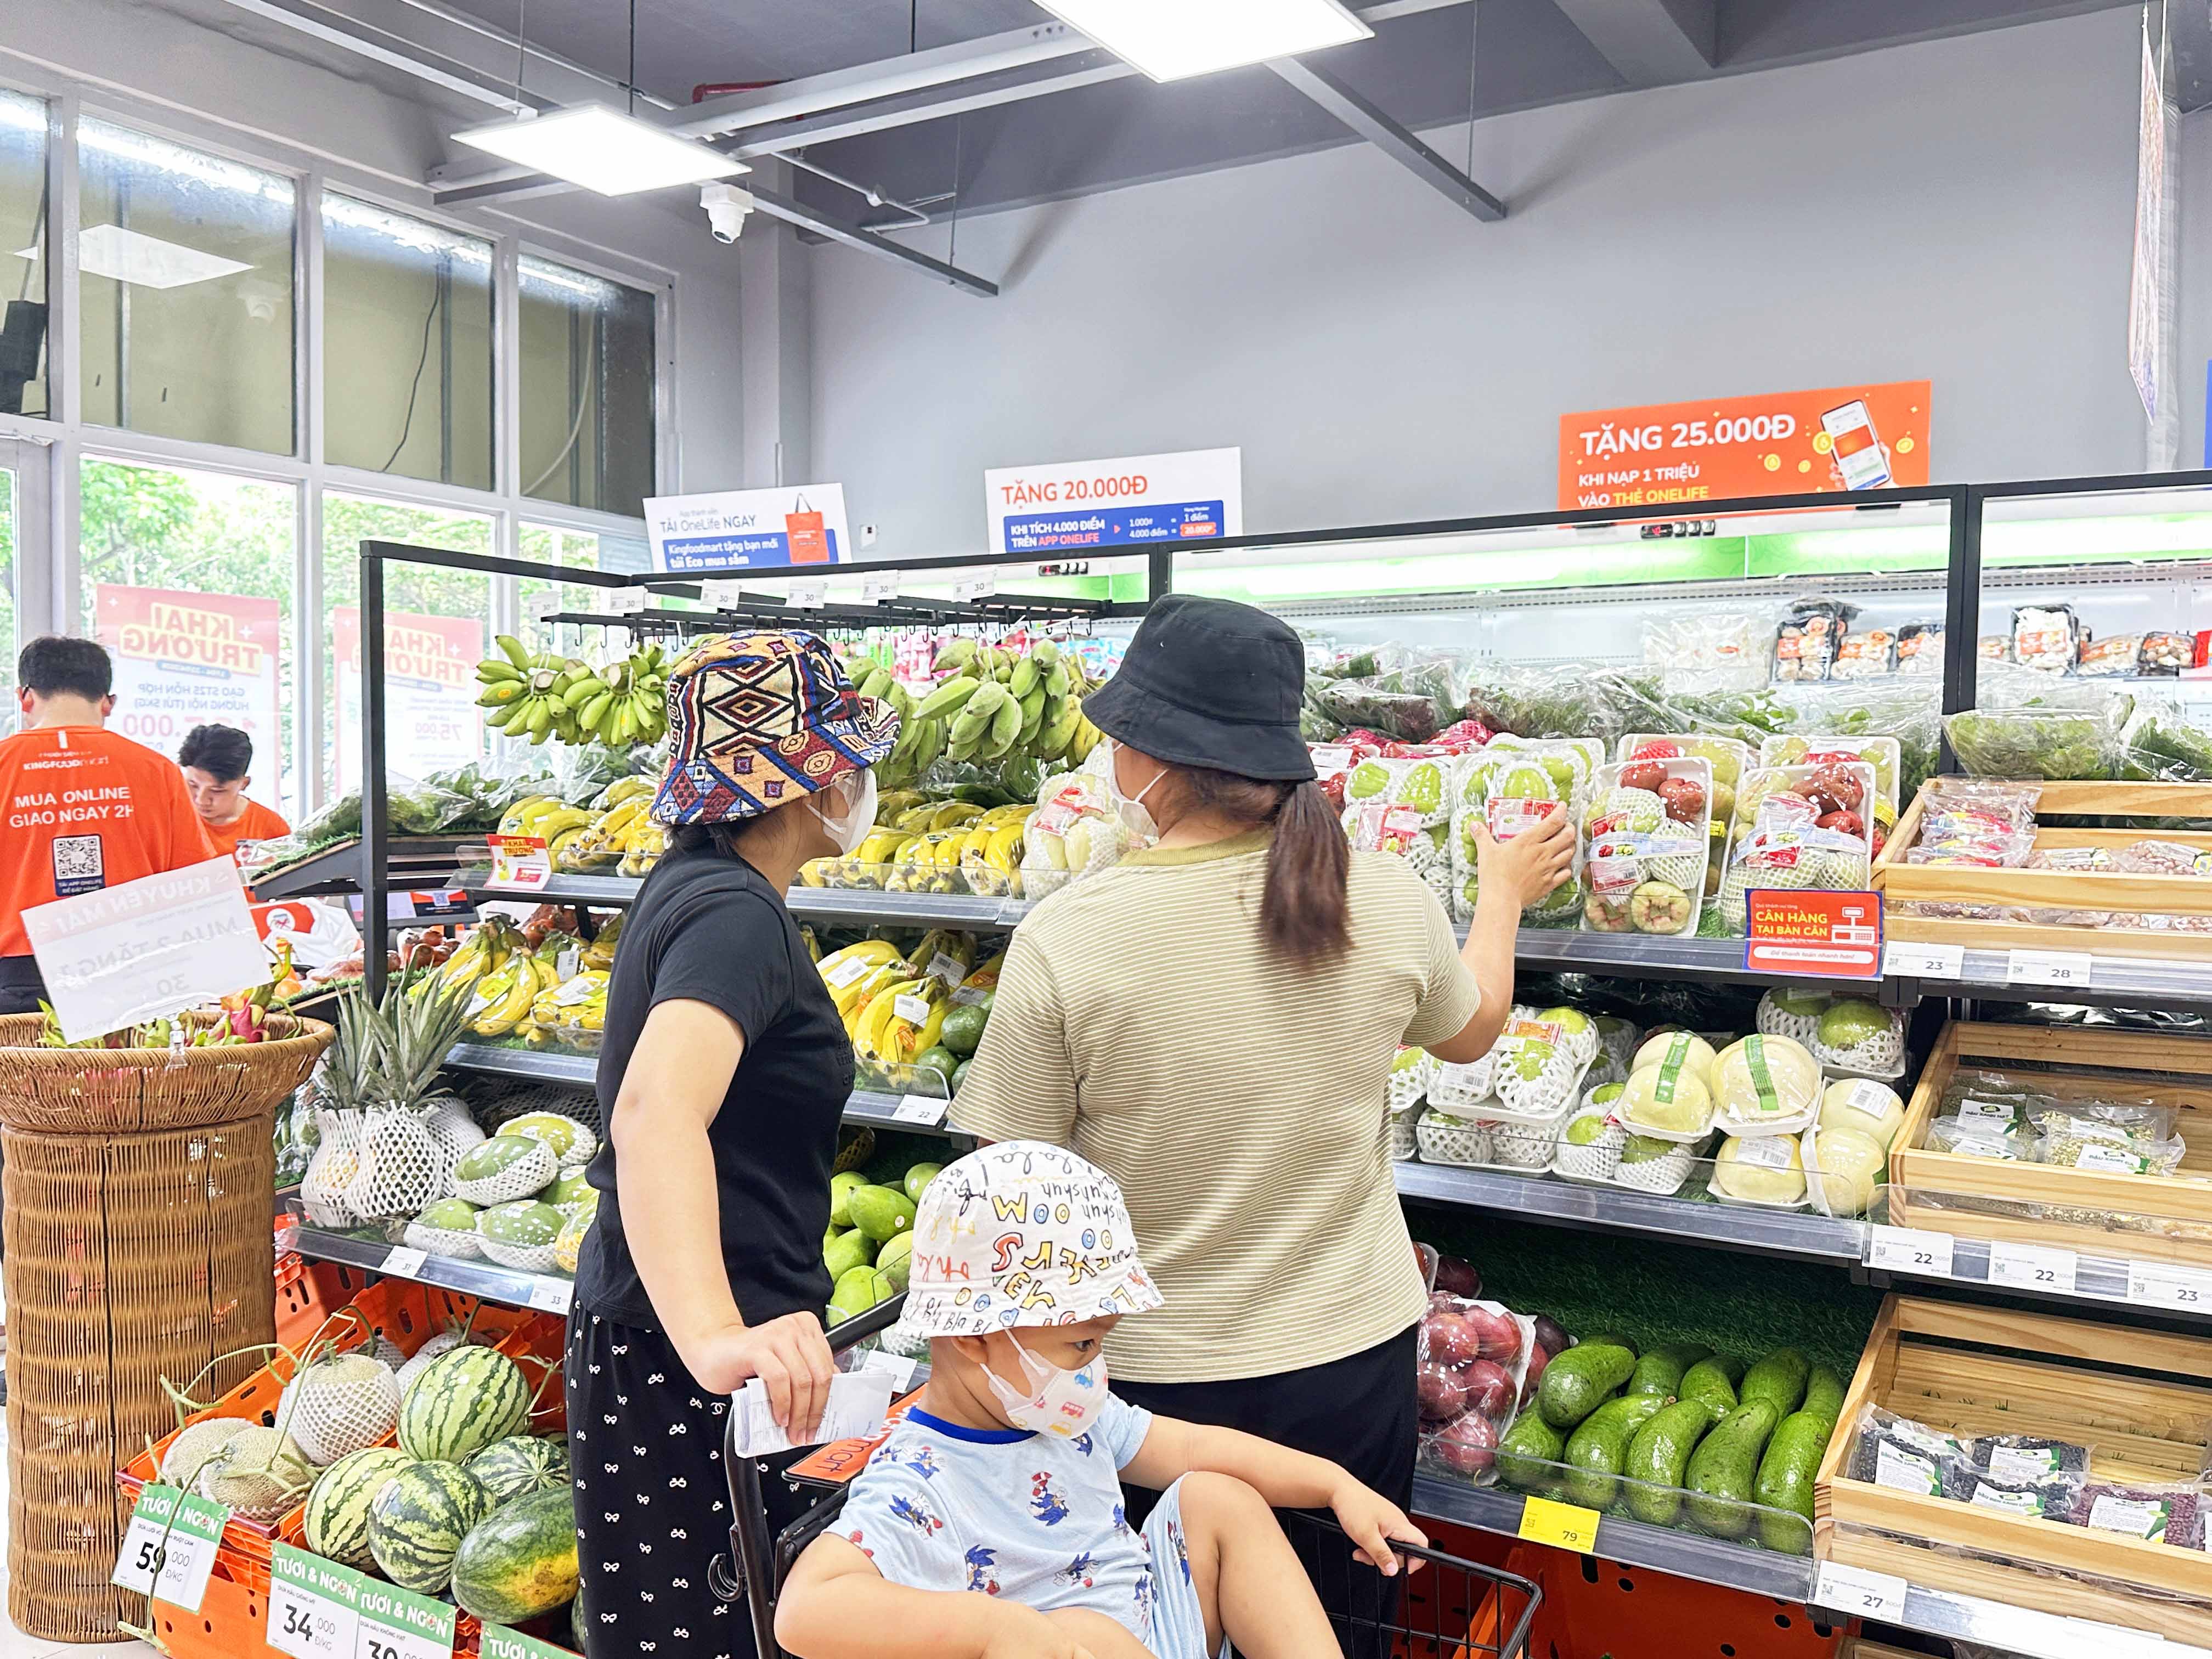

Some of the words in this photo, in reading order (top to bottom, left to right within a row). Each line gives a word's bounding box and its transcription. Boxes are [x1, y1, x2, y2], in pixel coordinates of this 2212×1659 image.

[1579, 422, 1663, 460] TẶNG
[1671, 415, 1796, 449] 25.000Đ
[1578, 471, 1604, 487] KHI
[1607, 469, 1640, 488] NẠP
[1643, 467, 1652, 482] 1
[1001, 479, 1058, 509] TẶNG
[1063, 475, 1148, 500] 20.000Đ
[1578, 490, 1610, 507] VÀO
[1613, 487, 1642, 504] THẺ
[1646, 486, 1709, 502] ONELIFE
[680, 517, 720, 532] OneLife
[723, 514, 757, 528] NGAY
[1011, 524, 1028, 535] KHI
[1029, 521, 1052, 534] TÍCH
[1011, 534, 1037, 548] TRÊN
[1038, 535, 1058, 546] APP
[1059, 533, 1100, 545] ONELIFE
[668, 542, 723, 556] Kingfoodmart
[685, 556, 704, 568] Eco
[704, 557, 727, 567] mua
[879, 585, 888, 593] 30
[975, 583, 985, 592] 30
[15, 792, 57, 808] MUA
[63, 786, 131, 804] ONLINE
[9, 810, 55, 828] GIAO
[59, 805, 110, 823] NGAY
[1756, 909, 1784, 922] CÂN
[1787, 910, 1828, 924] HÀNG
[1756, 924, 1774, 936] TẠI
[1776, 923, 1801, 935] BÀN
[1803, 924, 1828, 937] CÂN
[1925, 961, 1943, 970] 23
[2051, 969, 2070, 978] 28
[918, 1110, 931, 1119] 22
[1914, 1252, 1933, 1264] 22
[2035, 1269, 2055, 1282] 22
[551, 1295, 561, 1305] 33
[2177, 1289, 2198, 1302] 23
[141, 1496, 172, 1516] TƯƠI
[1562, 1530, 1578, 1542] 79
[136, 1541, 166, 1573] 59
[276, 1557, 306, 1580] TƯƠI
[308, 1567, 317, 1584] &
[360, 1591, 391, 1616] TƯƠI
[393, 1601, 404, 1618] &
[1863, 1595, 1883, 1608] 27
[283, 1603, 313, 1642] 34
